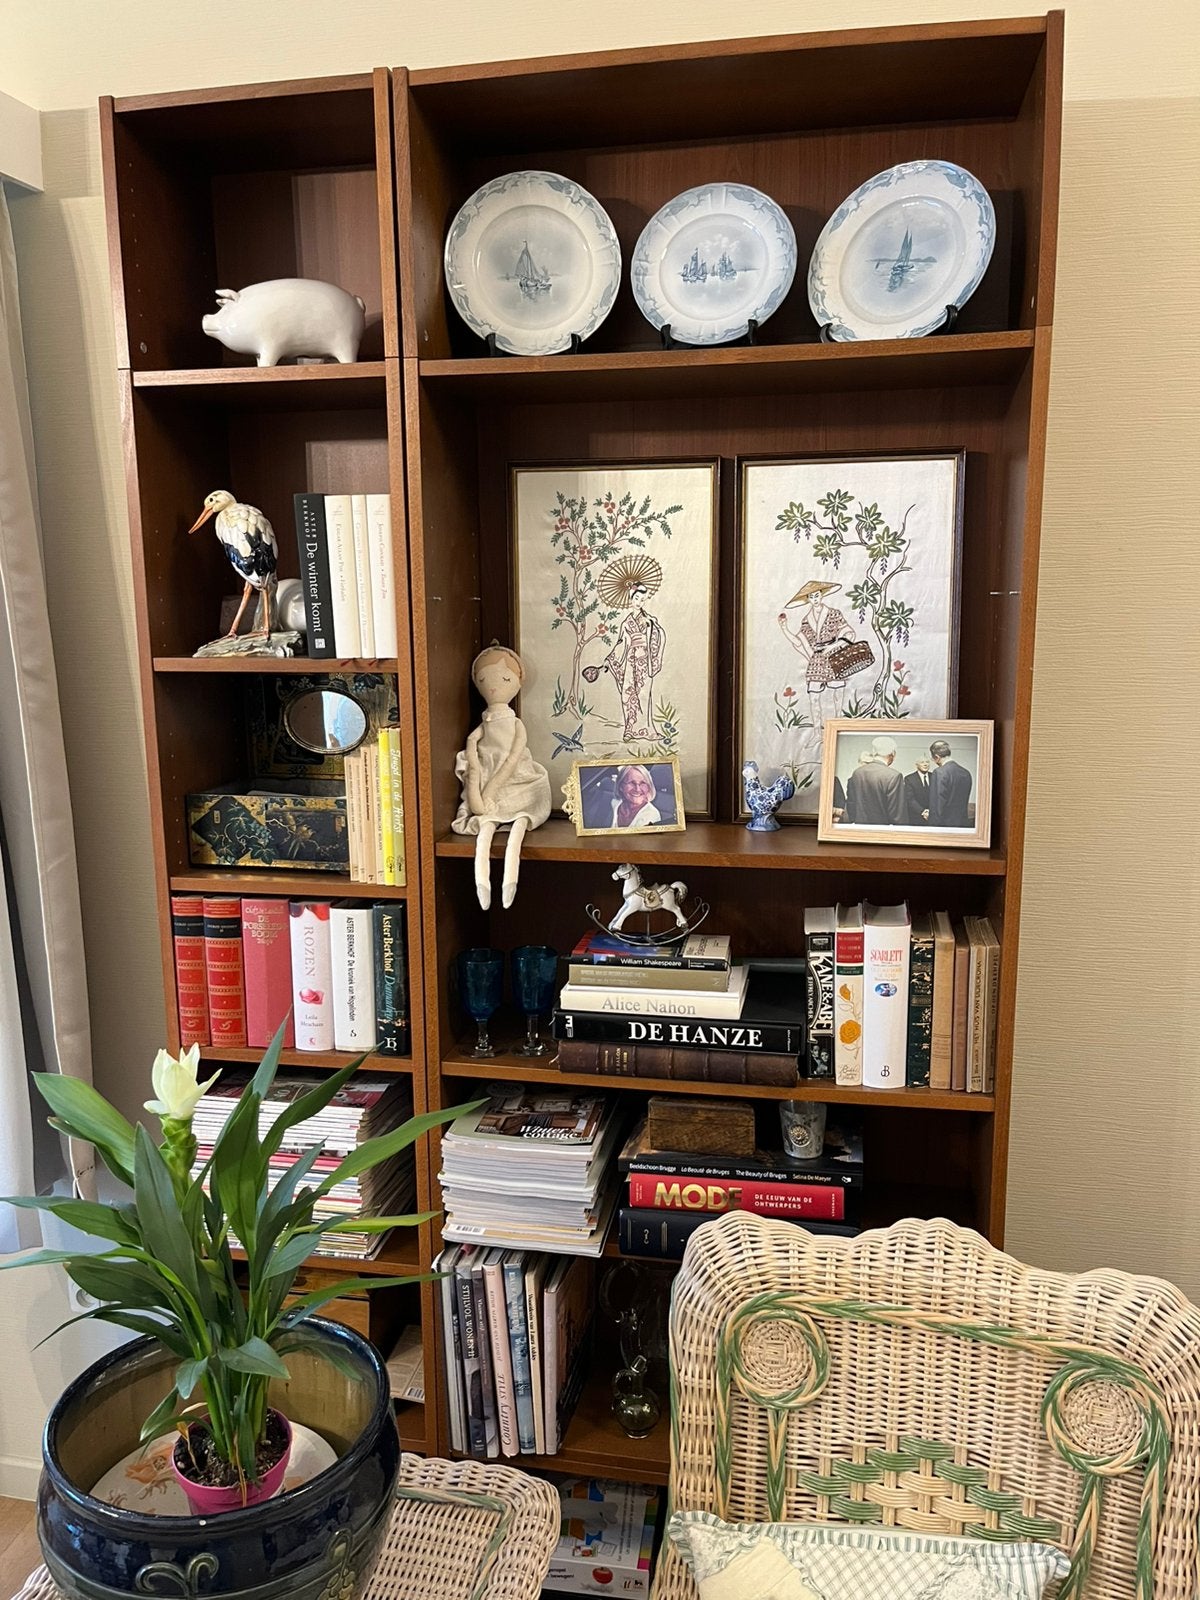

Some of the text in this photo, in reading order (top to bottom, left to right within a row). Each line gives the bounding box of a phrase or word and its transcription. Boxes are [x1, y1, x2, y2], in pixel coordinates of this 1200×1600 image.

[302, 499, 311, 539] BERKHOF
[309, 511, 317, 539] ASTER
[305, 542, 322, 632] De winter komt
[390, 748, 403, 834] Jeugd in de Herfst
[346, 917, 355, 934] ASTER
[383, 914, 394, 937] Aster
[303, 926, 315, 977] ROZEN
[346, 934, 355, 958] BERKHOF
[383, 937, 395, 972] Berkhof
[870, 949, 904, 963] SCARLETT
[621, 957, 643, 965] William
[643, 958, 682, 968] Shakespeare
[347, 967, 356, 985] kroniek
[602, 998, 696, 1015] Alice Nahon
[807, 996, 815, 1019] ARCHER
[628, 1021, 664, 1041] DE
[669, 1023, 763, 1047] HANZE
[520, 1124, 569, 1134] Winter
[522, 1131, 579, 1140] cottage
[629, 1162, 677, 1172] Beeldschoon Brugge
[712, 1168, 730, 1176] Bruges
[745, 1169, 763, 1178] Beauty
[769, 1171, 787, 1180] Bruges
[654, 1181, 743, 1211] MODE
[754, 1201, 802, 1210] ONTWERPERS
[765, 1194, 786, 1202] EEUW
[787, 1195, 802, 1203] VAN
[803, 1196, 813, 1204] DE
[461, 1284, 472, 1319] STIJLVOL
[465, 1319, 474, 1349] WONEN
[497, 1373, 512, 1446] Country STYLE
